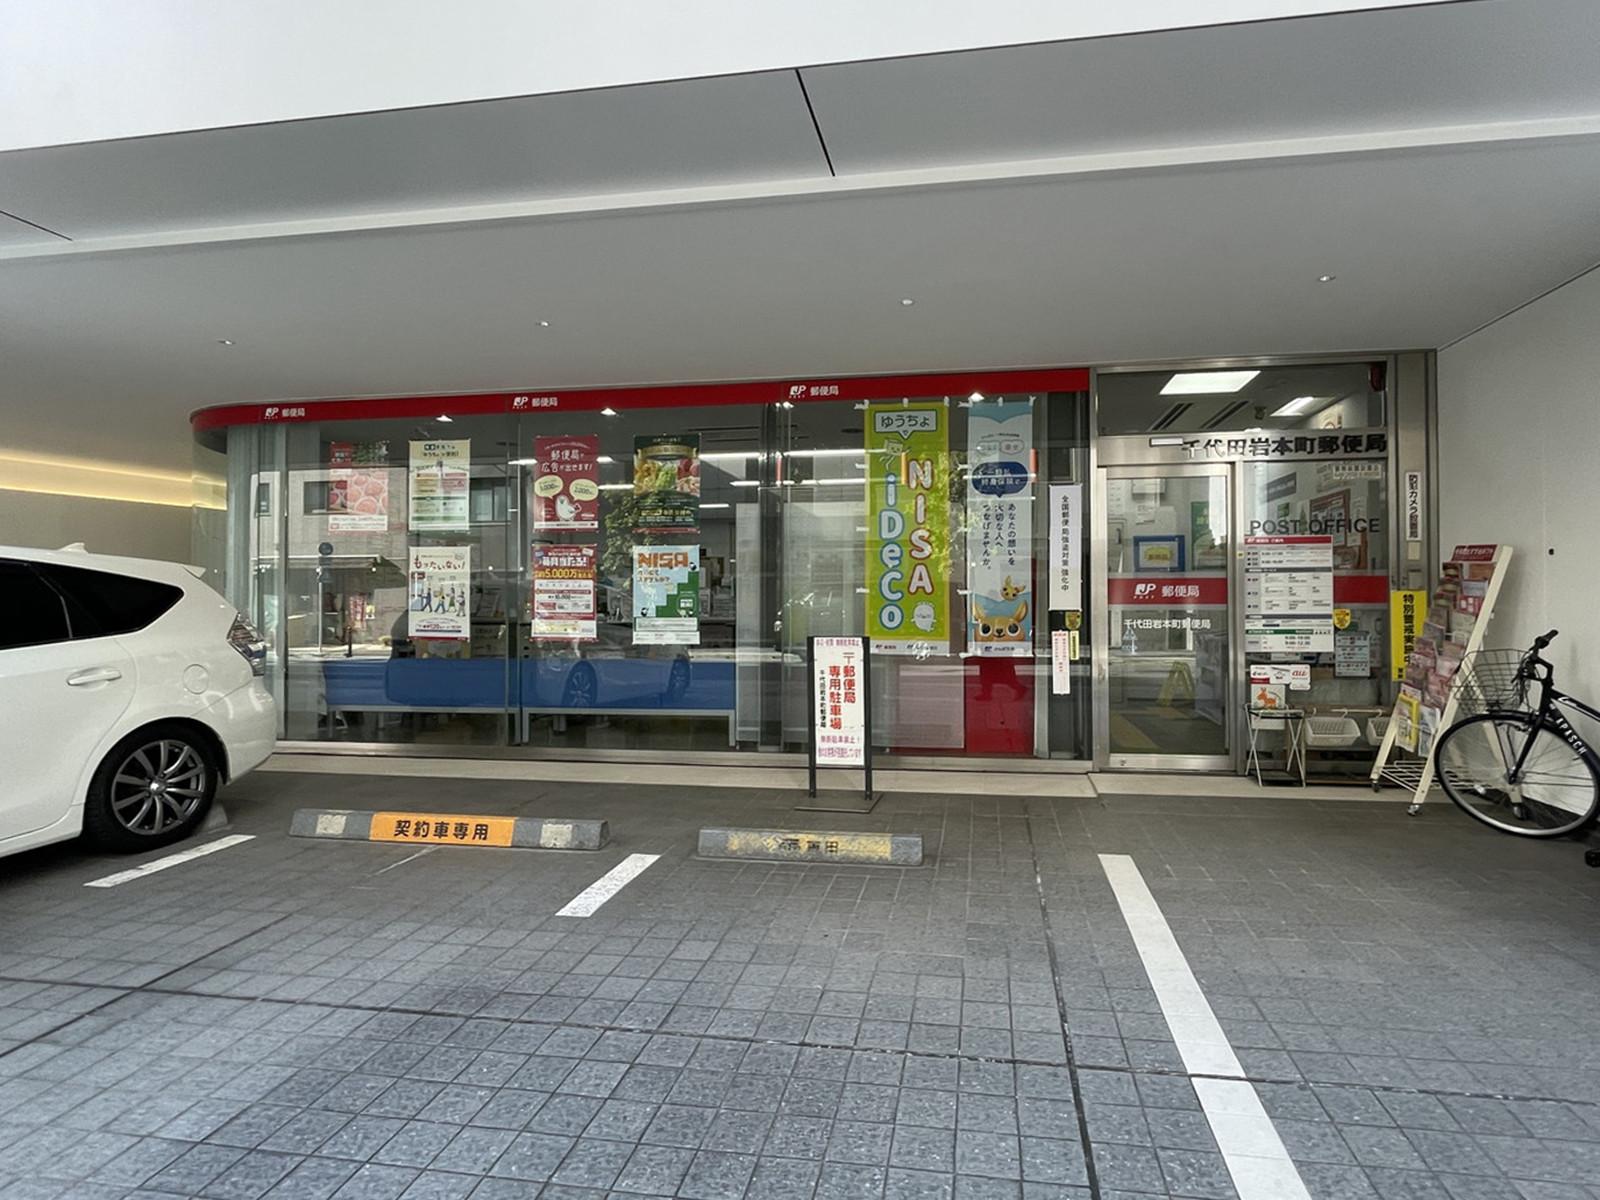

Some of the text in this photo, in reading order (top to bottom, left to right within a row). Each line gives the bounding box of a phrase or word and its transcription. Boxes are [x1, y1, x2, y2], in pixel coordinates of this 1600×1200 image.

[810, 386, 839, 396] 郵便局
[532, 397, 558, 407] 郵便局
[282, 407, 306, 417] 郵便局
[881, 414, 930, 428] ゆうちょ
[1182, 434, 1387, 459] 千代田岩本町郵便局
[908, 459, 935, 595] NISA
[995, 505, 1004, 547] 大切な人へ
[1250, 518, 1381, 534] POST OFFICE
[1008, 503, 1016, 566] あなたの想いを
[879, 472, 905, 630] iDeCo
[414, 554, 466, 570] もったいない!
[638, 552, 689, 568] NISA
[1162, 585, 1199, 597] 郵便局
[1124, 618, 1211, 629] 千代田岩本町郵便局
[829, 665, 842, 730] 専用駐車場
[394, 819, 489, 841] 契約車専用
